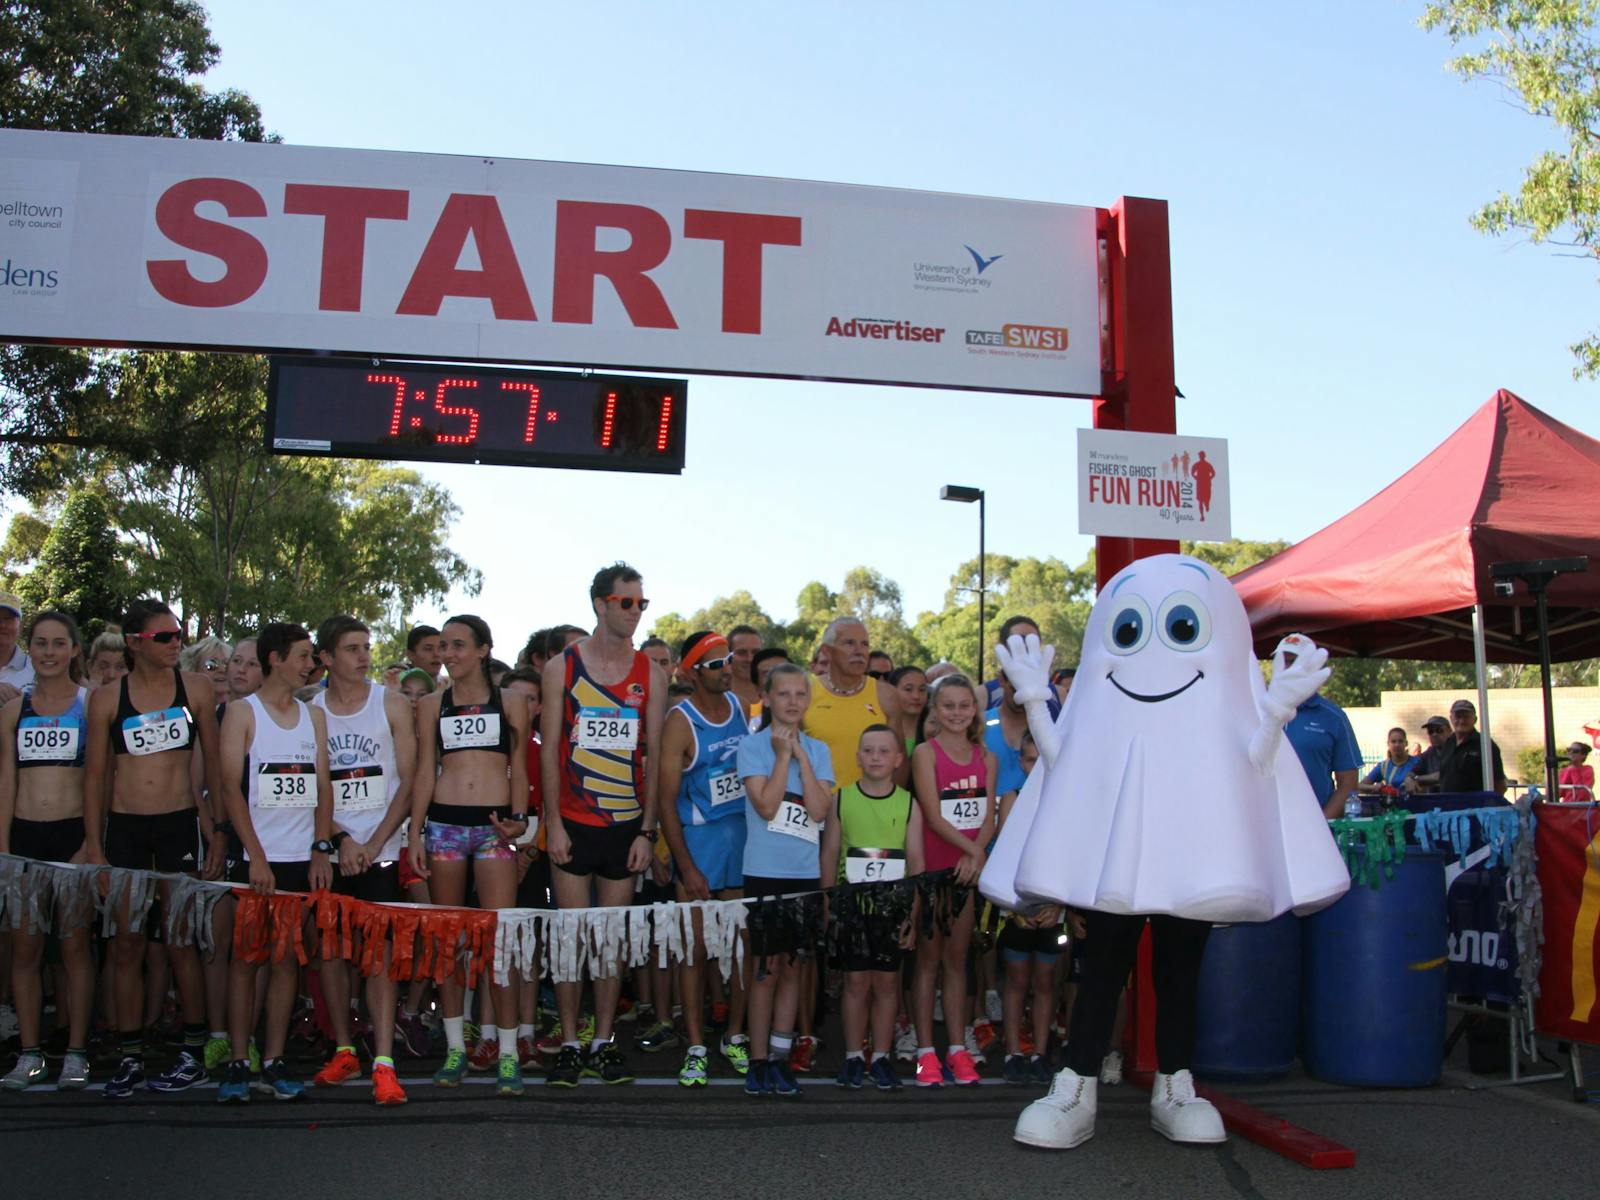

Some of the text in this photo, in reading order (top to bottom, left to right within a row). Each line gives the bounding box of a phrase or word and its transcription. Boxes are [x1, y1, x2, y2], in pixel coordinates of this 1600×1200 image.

[8, 219, 62, 229] city council
[146, 177, 803, 335] START
[913, 262, 971, 276] University of
[914, 272, 992, 288] Western Sydney
[825, 317, 945, 343] Advertiser
[1088, 463, 1157, 478] FISHER'S GHOST
[1089, 475, 1181, 508] FUN RUN
[1181, 482, 1193, 509] 2014
[453, 717, 486, 736] 320
[587, 720, 630, 738] 5284
[24, 730, 70, 748] 5089
[328, 733, 381, 757] HLETICS
[273, 777, 306, 795] 338
[341, 780, 369, 800] 271
[717, 774, 746, 796] 523
[786, 806, 809, 828] 122
[953, 801, 980, 818] 423
[865, 861, 886, 877] 67
